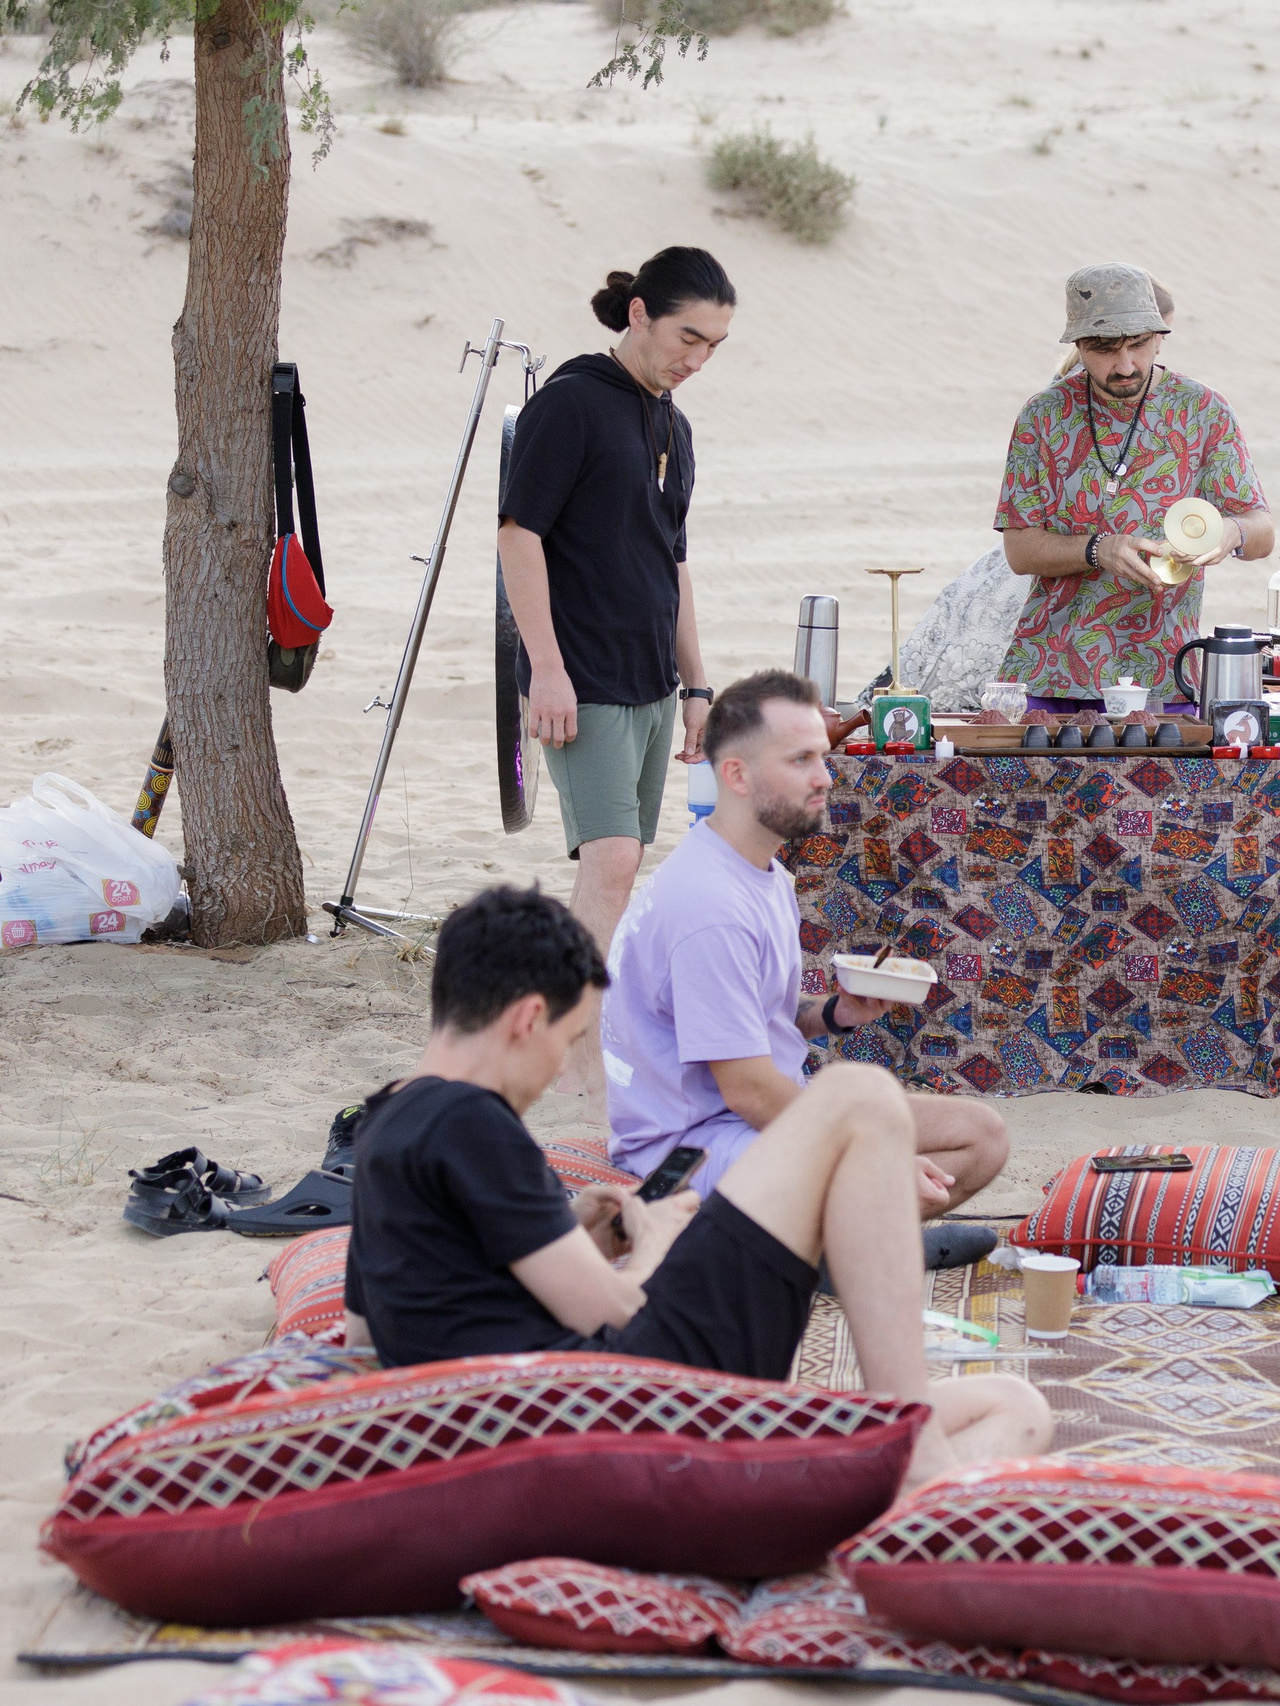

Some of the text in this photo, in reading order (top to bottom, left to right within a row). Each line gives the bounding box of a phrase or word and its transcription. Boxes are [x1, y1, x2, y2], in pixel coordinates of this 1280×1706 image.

[111, 881, 131, 897] 24
[112, 895, 131, 903] open
[98, 913, 118, 929] 24
